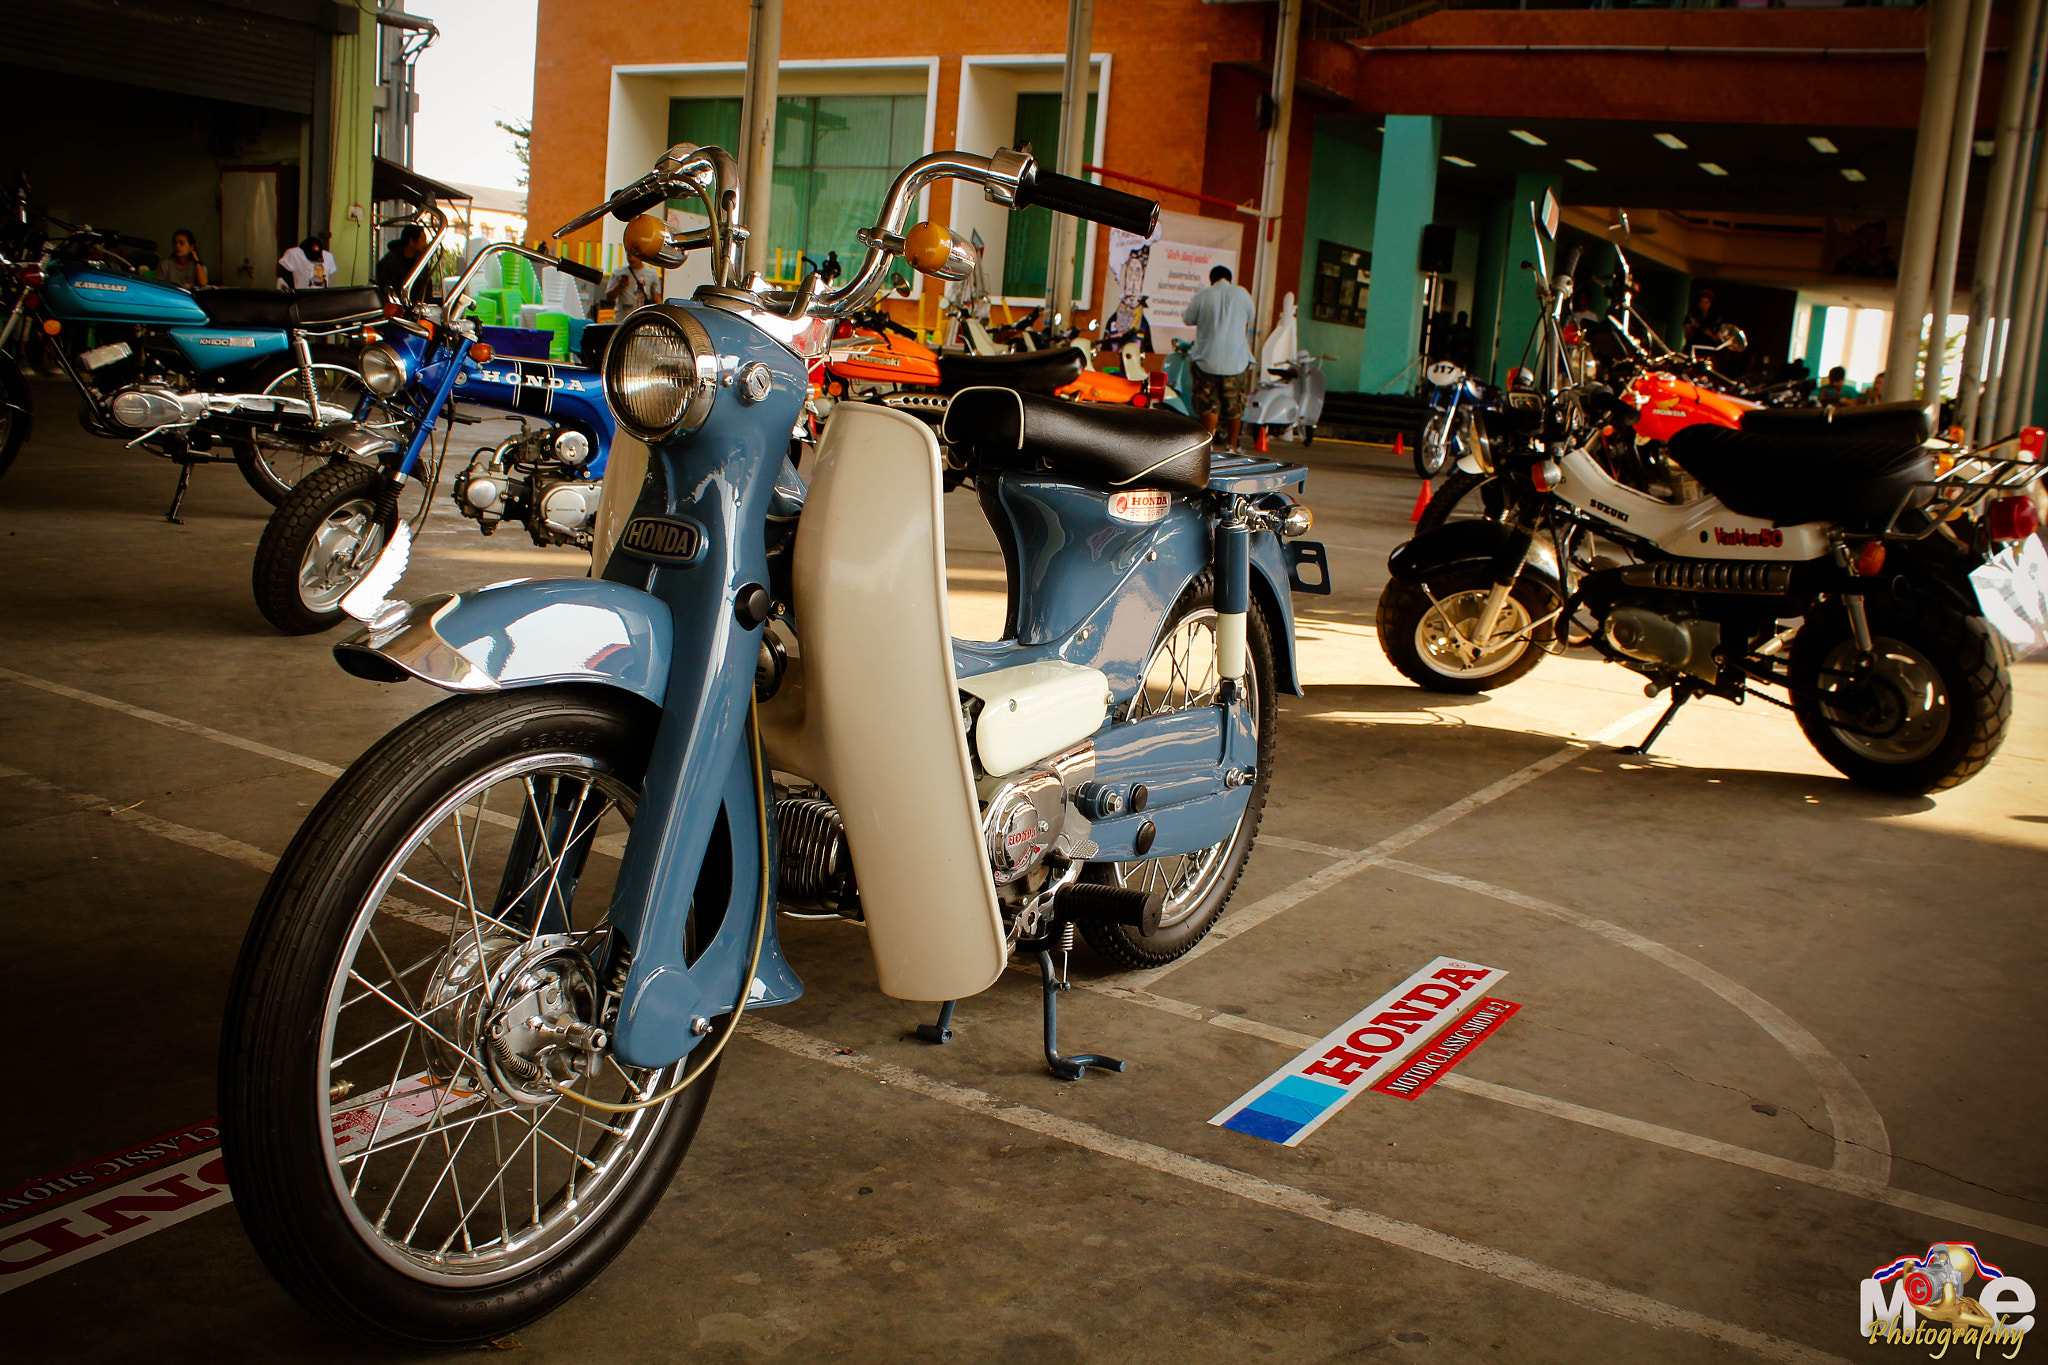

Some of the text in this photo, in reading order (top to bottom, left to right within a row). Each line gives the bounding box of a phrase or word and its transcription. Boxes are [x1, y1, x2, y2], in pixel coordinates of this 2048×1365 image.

[74, 281, 127, 292] KAWASAKI
[481, 370, 587, 392] HONDA
[1131, 496, 1168, 506] HONDA
[1590, 498, 1630, 522] SUZUKI
[626, 521, 690, 554] HONDA
[1008, 826, 1037, 847] HONDA
[1302, 966, 1492, 1086] HONDA
[1386, 1061, 1442, 1095] MOTOR
[1425, 1030, 1477, 1063] CLASSIC
[1461, 1009, 1500, 1034] SHOW
[93, 1126, 221, 1176] CLASSIC
